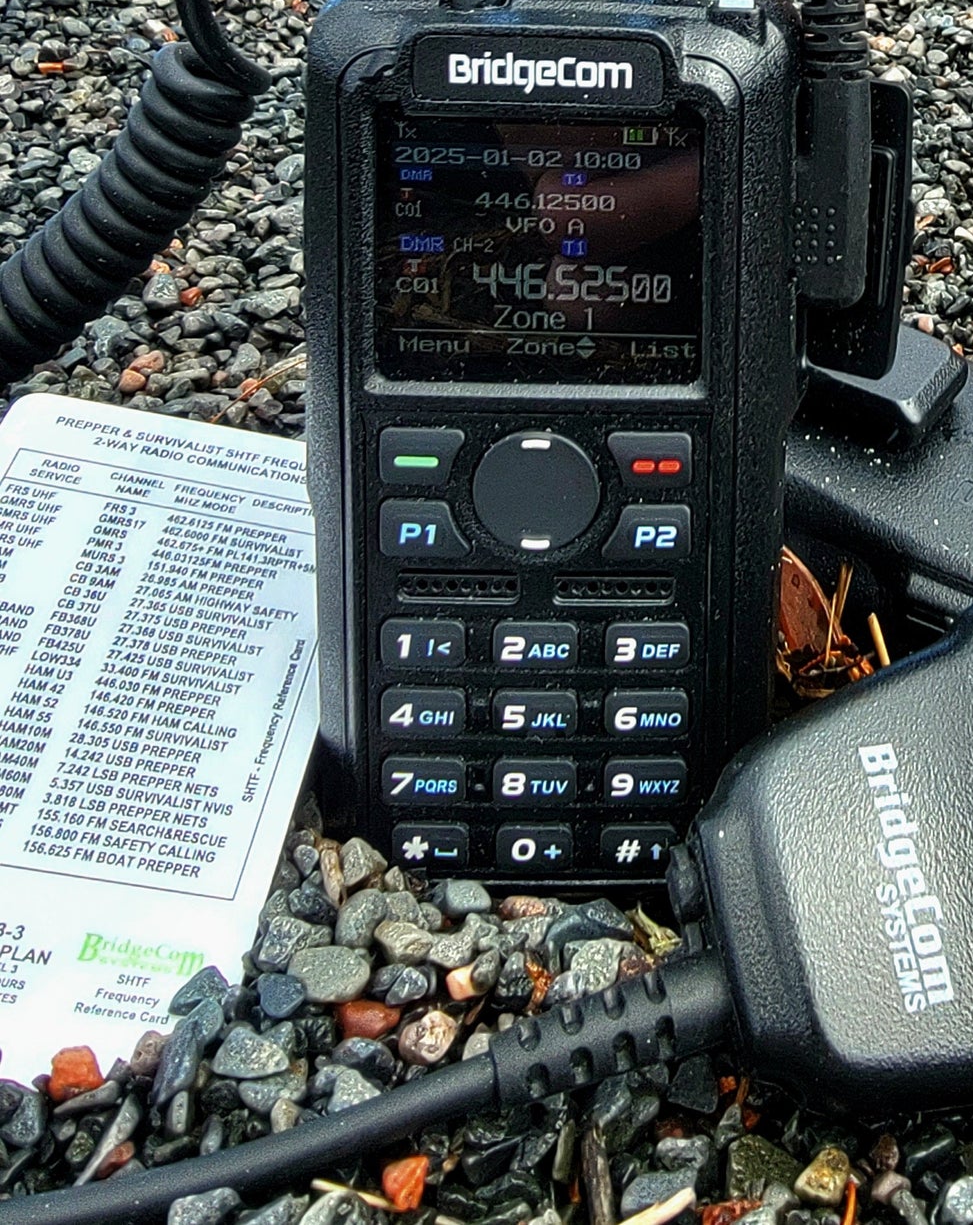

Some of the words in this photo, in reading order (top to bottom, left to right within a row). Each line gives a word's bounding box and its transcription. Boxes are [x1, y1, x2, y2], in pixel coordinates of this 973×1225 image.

[449, 51, 633, 94] BridgeCom
[395, 147, 563, 165] 2025-01-02
[573, 151, 642, 169] 10:00
[401, 169, 432, 181] DMR
[474, 192, 616, 212] 446.12500
[505, 217, 555, 233] VFO
[567, 218, 585, 234] A
[400, 236, 444, 252] DMR
[454, 239, 494, 253] CH-2
[565, 240, 585, 255] T1
[395, 277, 439, 294] C01
[472, 262, 672, 303] 446.52500
[494, 305, 566, 329] Zone
[584, 308, 594, 330] 1
[399, 336, 470, 354] Menu
[507, 338, 575, 355] Zone
[631, 341, 696, 358] List
[56, 416, 120, 436] PREPPER
[136, 432, 223, 455] SURVIVALIST
[226, 449, 260, 462] SHTF
[93, 437, 138, 452] 2-WAY
[140, 446, 183, 461] RADIO
[29, 468, 82, 485] SERVICE
[42, 459, 80, 472] RADIO
[111, 472, 165, 489] CHANNEL
[174, 484, 246, 504] FREQUENCY
[115, 485, 151, 498] NAME
[201, 501, 237, 514] MODE
[399, 523, 436, 545] P1
[634, 526, 678, 548] P2
[64, 586, 81, 596] CB
[83, 590, 107, 601] 36U
[57, 598, 75, 609] CB
[77, 602, 101, 614] 37U
[169, 605, 194, 616] USB
[196, 609, 274, 631] SURVIVALIST
[174, 592, 192, 603] AM
[195, 595, 251, 613] HIGHWAY
[252, 606, 299, 622] SAFETY
[124, 610, 161, 624] 27.375
[163, 617, 189, 629] USB
[190, 621, 247, 640] PREPPER
[112, 636, 150, 651] 27.378
[152, 643, 178, 656] USB
[180, 647, 237, 666] PREPPER
[158, 629, 183, 642] USB
[185, 635, 264, 657] SURVIVALIST
[397, 634, 411, 659] 1
[501, 637, 526, 660] 2
[528, 644, 570, 659] ABC
[614, 638, 636, 662] 3
[641, 644, 680, 659] DEF
[24, 664, 55, 678] HAM
[56, 669, 73, 681] U3
[106, 649, 145, 664] 27.425
[146, 656, 173, 669] USB
[175, 660, 254, 683] SURVIVALIST
[18, 677, 49, 692] HAM
[49, 684, 65, 694] 42
[101, 663, 139, 677] 33.400
[141, 669, 159, 680] FM
[162, 673, 242, 695] SURVIVALIST
[11, 691, 42, 705] HAM
[43, 697, 59, 709] 52
[95, 677, 140, 693] 446.030
[142, 684, 160, 696] FM
[162, 687, 221, 706] PREPPER
[4, 705, 35, 720] HAM
[36, 711, 53, 723] 55
[90, 689, 134, 706] 146.420
[136, 698, 156, 709] FM
[156, 700, 216, 720] PREPPER
[389, 704, 414, 726] 4
[419, 711, 454, 724] GHI
[84, 704, 128, 720] 146.520
[130, 712, 149, 724] FM
[152, 715, 181, 729] HAM
[183, 721, 237, 738] CALLING
[242, 773, 260, 802] SHTF
[254, 712, 283, 765] Frequency
[273, 663, 297, 710] Reference
[290, 639, 306, 661] Card
[502, 705, 526, 729] 5
[531, 713, 567, 727] JKL
[614, 707, 637, 730] 6
[639, 713, 681, 727] MNO
[78, 718, 122, 734] 146.550
[124, 726, 143, 738] FM
[145, 729, 229, 753] SURVIVALIST
[69, 733, 110, 748] 28.305
[112, 739, 139, 753] USB
[140, 743, 201, 764] PREPPER
[65, 747, 104, 762] 14.242
[105, 753, 133, 767] USB
[135, 758, 196, 778] PREPPER
[57, 762, 90, 776] 7.242
[92, 767, 118, 781] LSB
[121, 772, 182, 792] PREPPER
[184, 782, 219, 797] NETS
[390, 773, 414, 795] 7
[414, 780, 457, 792] PQRS
[501, 774, 526, 795] 8
[530, 780, 568, 794] TUV
[610, 774, 634, 797] 9
[639, 780, 680, 794] WXYZ
[49, 777, 84, 792] 5.357
[86, 782, 113, 796] USB
[116, 788, 202, 811] SURVIVALIST
[203, 801, 233, 816] NVIS
[43, 792, 77, 807] 3.818
[79, 798, 106, 812] LSB
[108, 803, 171, 823] PREPPER
[173, 813, 208, 829] NETS
[38, 808, 85, 825] 155.160
[86, 816, 108, 829] FM
[109, 820, 228, 848] SEARCH&RESCUE
[31, 824, 78, 841] 156.800
[80, 832, 101, 845] FM
[103, 835, 156, 853] SAFETY
[158, 844, 216, 863] CALLING
[615, 839, 641, 862] #
[23, 840, 72, 858] 156.625
[73, 848, 94, 861] FM
[96, 851, 136, 868] BOAT
[137, 858, 201, 878] PREPPER
[858, 743, 954, 1005] BridgeCom
[0, 945, 52, 966] PLAN
[77, 932, 205, 976] BridgeCom
[876, 883, 927, 1013] SYSTEMS
[117, 974, 151, 988] SHTF
[95, 988, 160, 1009] Frequency
[74, 1002, 136, 1021] Reference
[140, 1011, 170, 1025] Card
